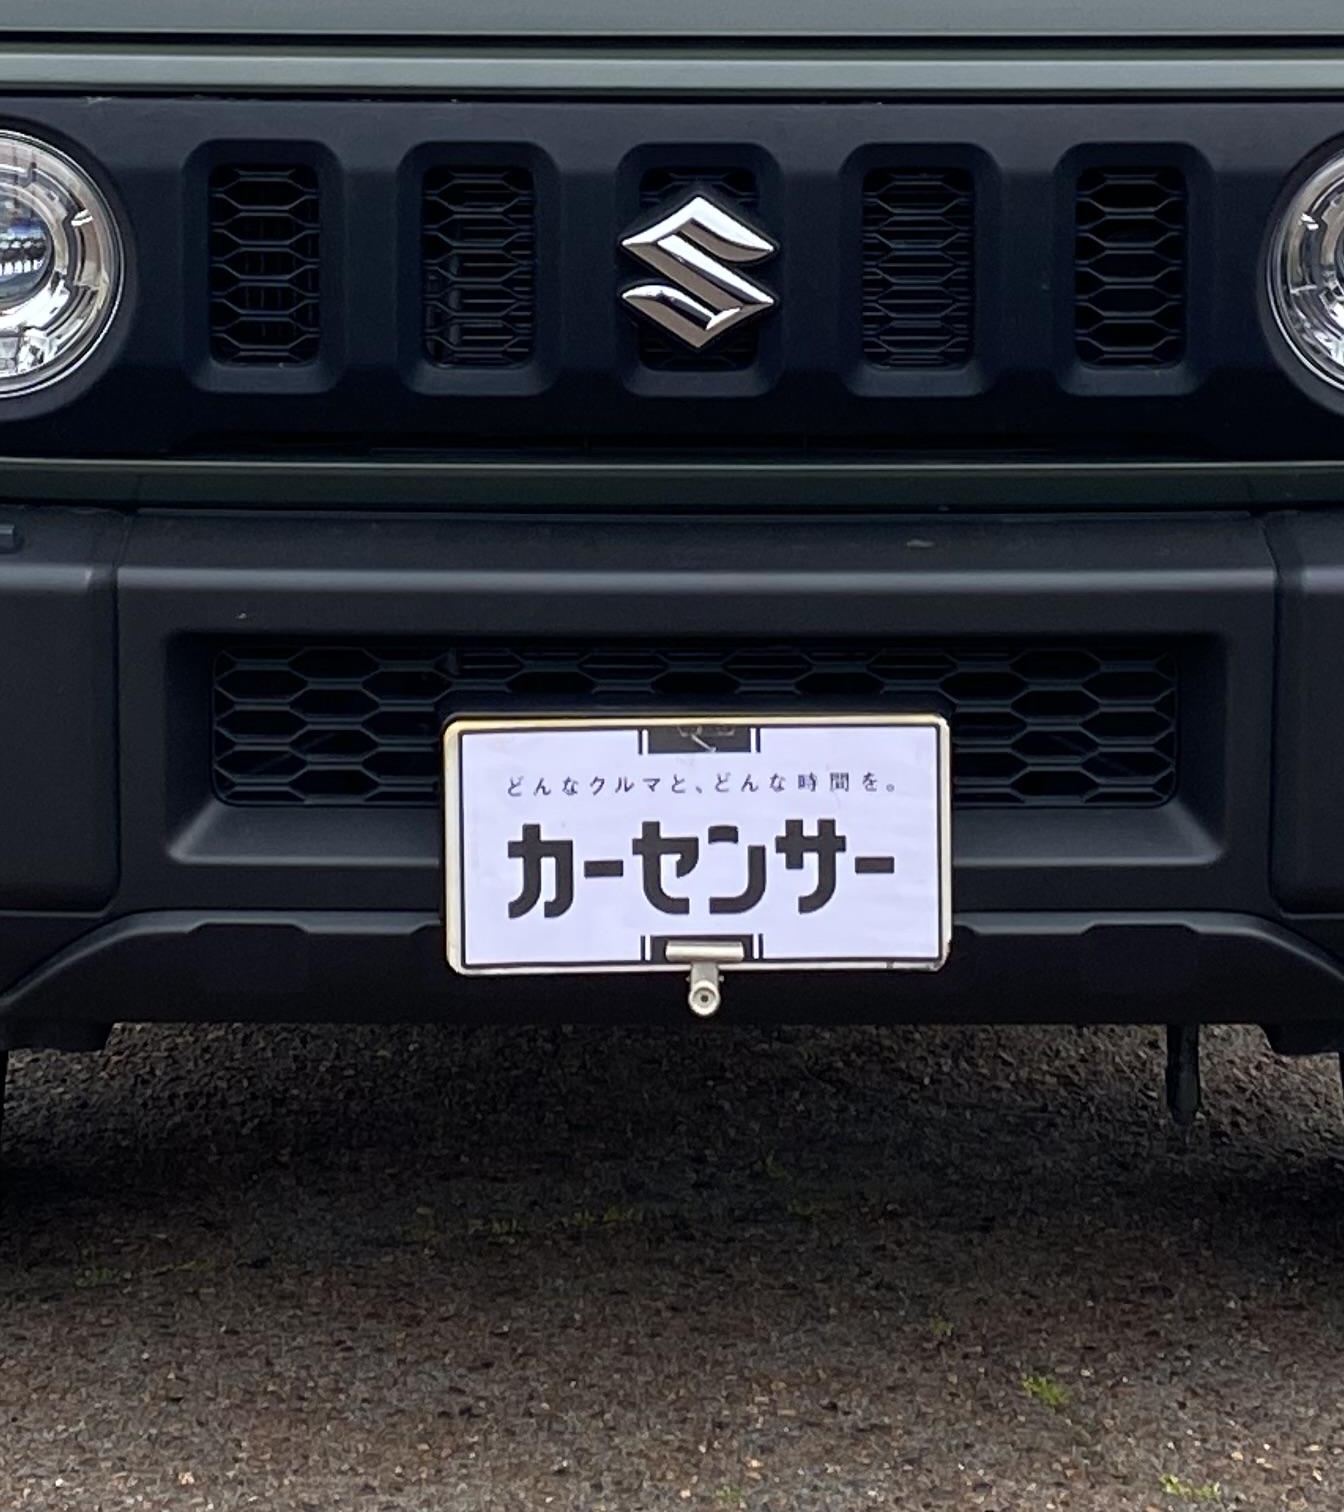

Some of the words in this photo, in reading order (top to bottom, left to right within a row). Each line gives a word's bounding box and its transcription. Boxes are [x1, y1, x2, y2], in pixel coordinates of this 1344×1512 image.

[507, 817, 895, 919] カーセンサー
